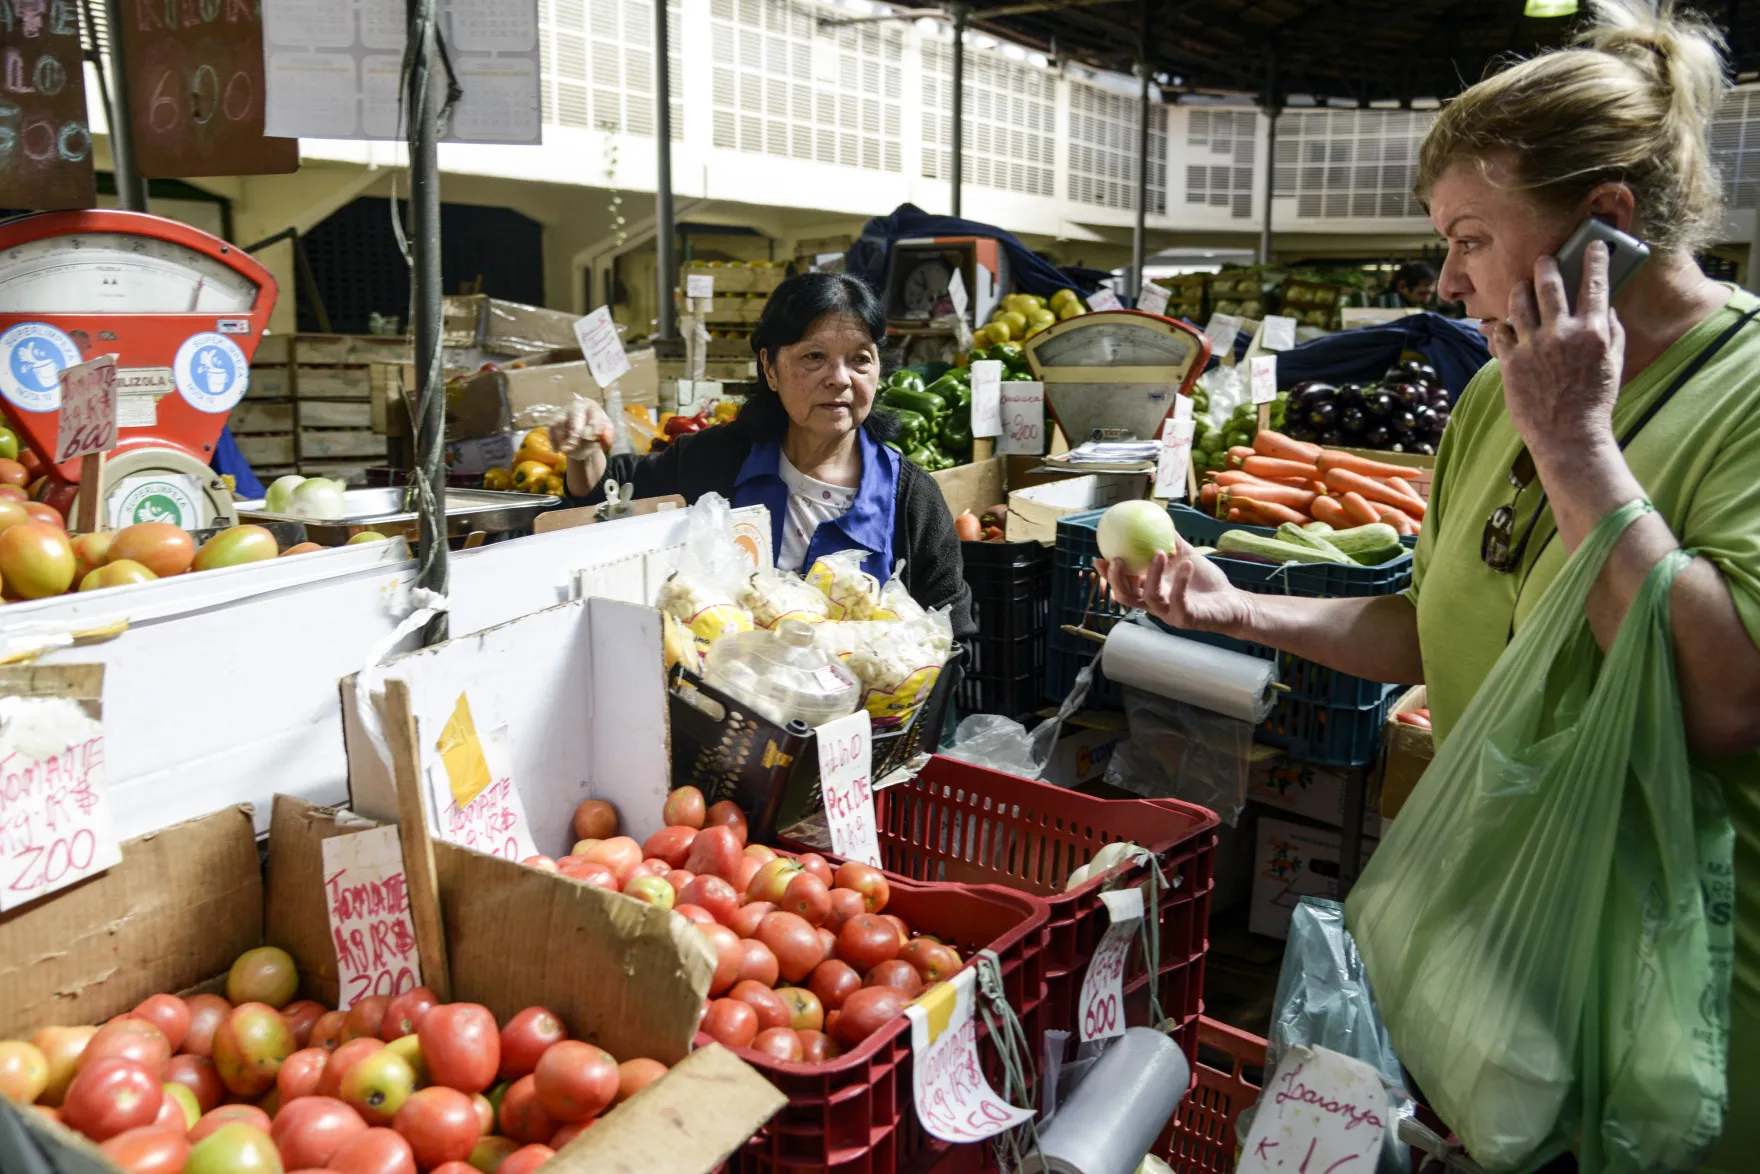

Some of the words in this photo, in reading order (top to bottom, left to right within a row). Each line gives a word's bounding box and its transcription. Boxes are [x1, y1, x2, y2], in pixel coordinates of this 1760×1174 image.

[151, 64, 252, 133] 600
[62, 421, 113, 459] 600
[326, 868, 409, 924] TOMATE
[1085, 990, 1117, 1039] 600
